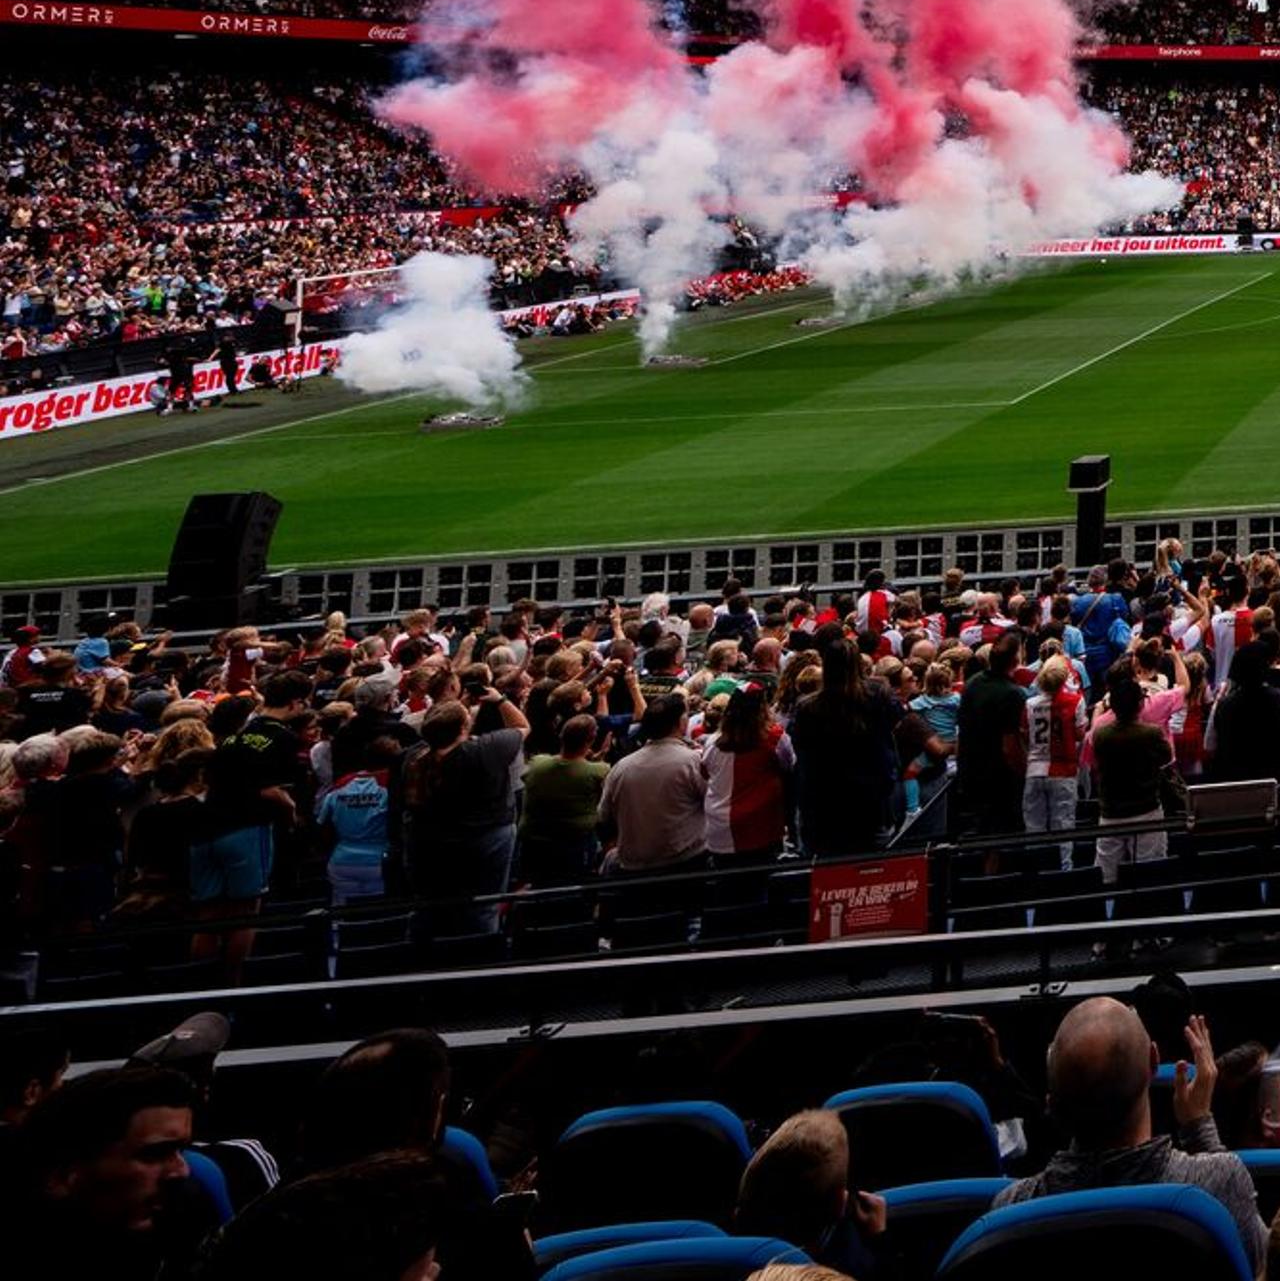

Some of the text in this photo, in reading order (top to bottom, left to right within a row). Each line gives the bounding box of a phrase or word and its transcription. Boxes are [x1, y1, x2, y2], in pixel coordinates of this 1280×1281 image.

[12, 3, 100, 23] ORMER
[201, 14, 278, 33] ORMER
[1090, 238, 1121, 252] het
[1121, 238, 1151, 254] jou
[1153, 236, 1228, 251] uitkomt.
[0, 391, 92, 432] roger
